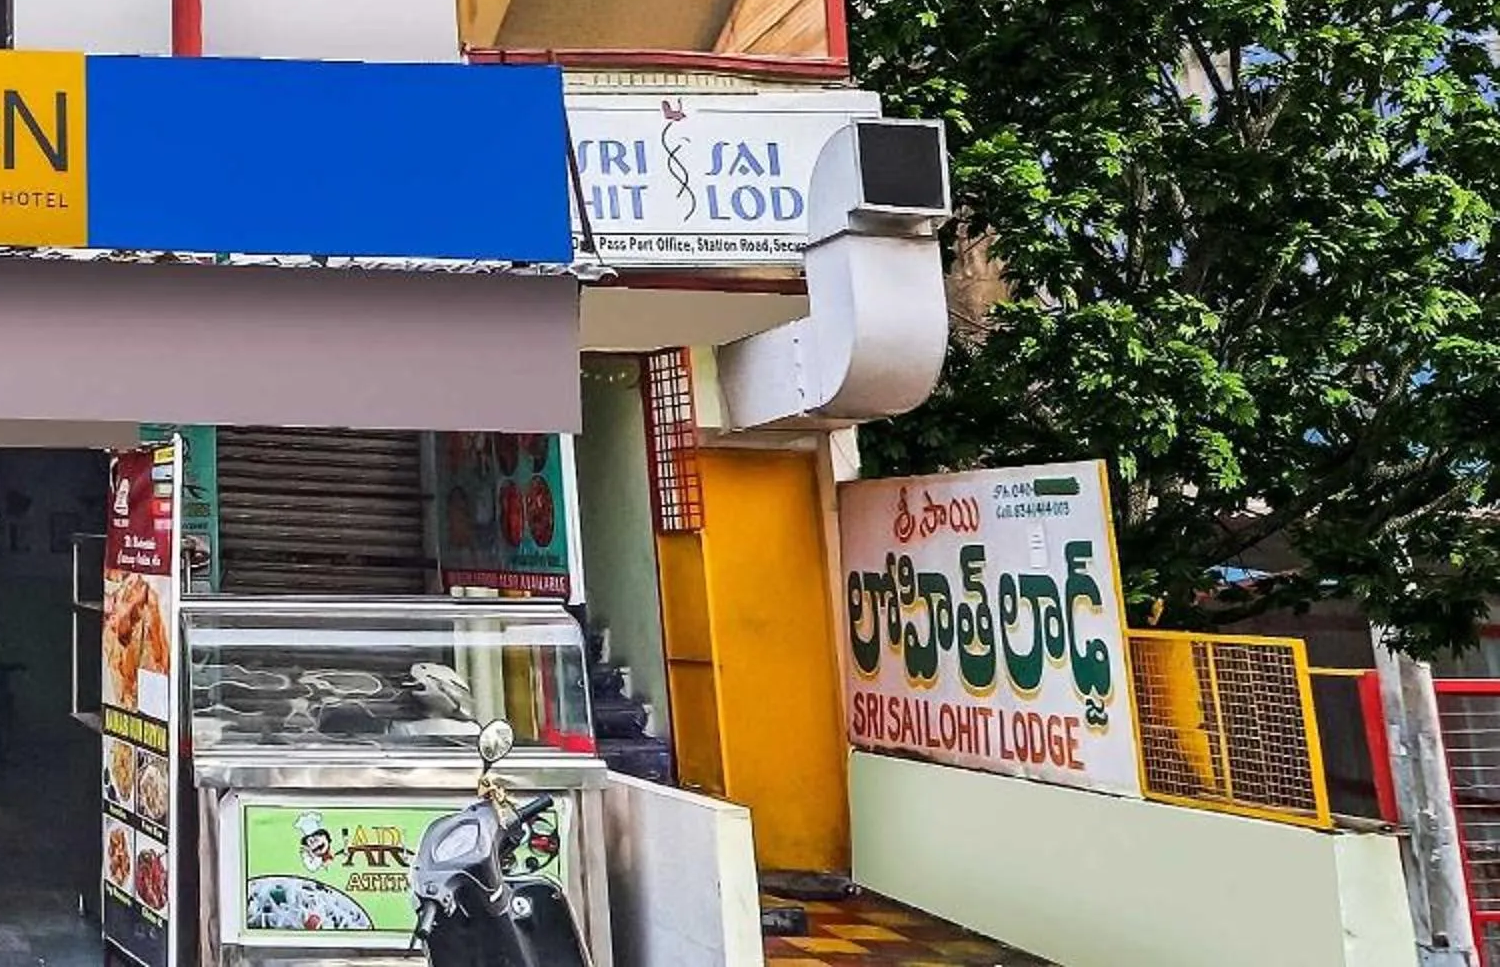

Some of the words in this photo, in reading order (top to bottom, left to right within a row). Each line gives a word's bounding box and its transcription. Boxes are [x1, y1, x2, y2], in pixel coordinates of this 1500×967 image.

[577, 140, 648, 175] SRI
[705, 141, 781, 177] SAI
[1, 191, 69, 209] HOTEL
[706, 185, 804, 221] LOD
[600, 236, 626, 251] Pass
[656, 237, 694, 254] Office,
[698, 238, 737, 252] Station
[853, 692, 884, 740] SRI
[887, 696, 923, 746] SAI
[924, 700, 994, 757] LOHIT
[999, 710, 1085, 770] LODGE
[346, 872, 411, 892] ATIT
